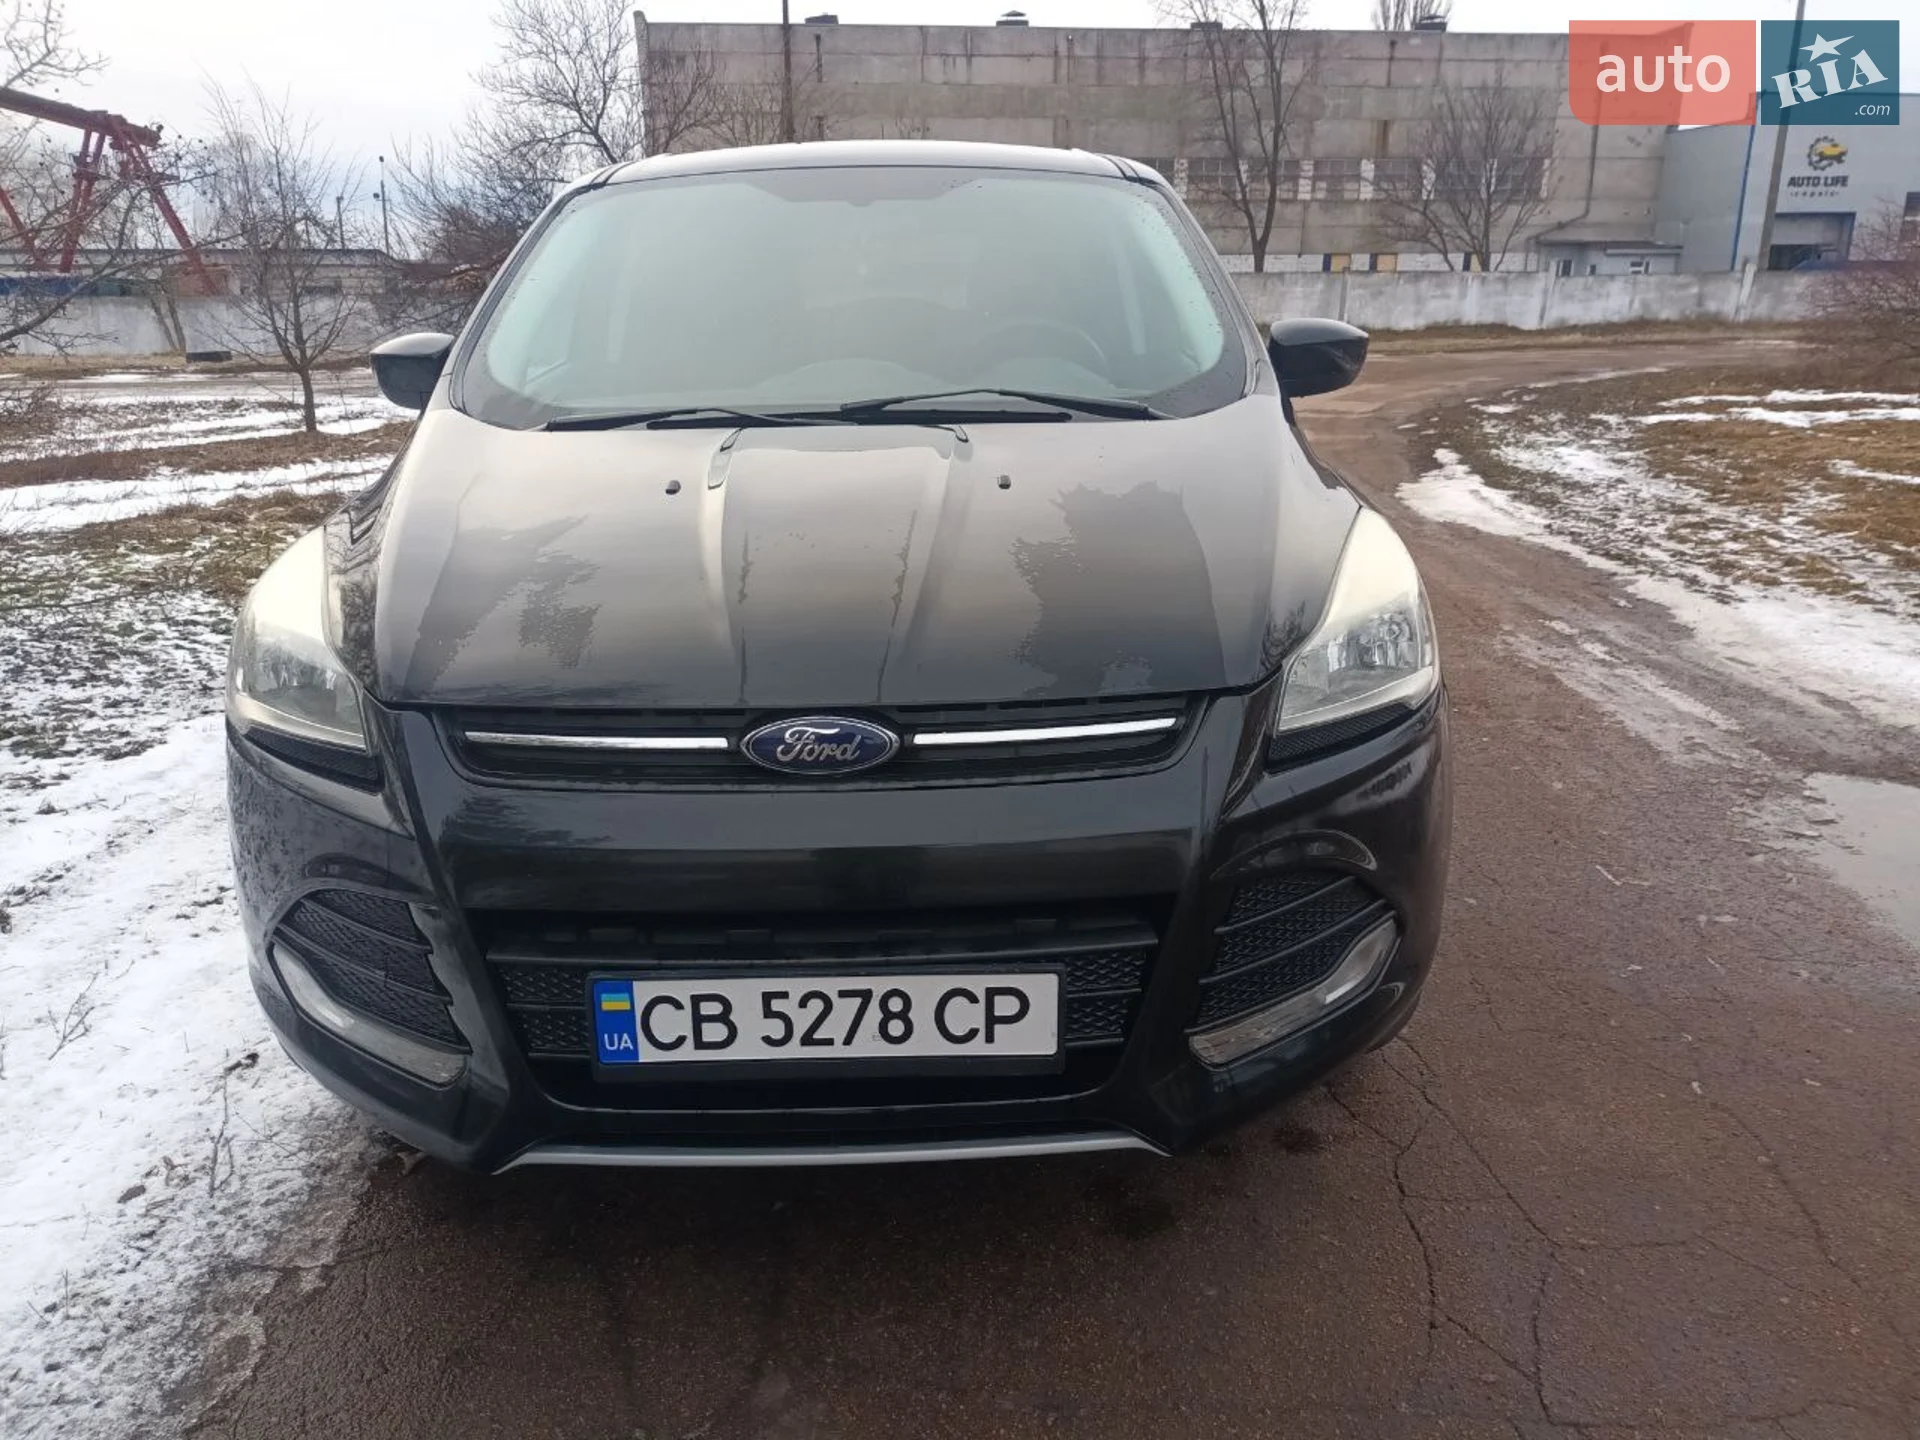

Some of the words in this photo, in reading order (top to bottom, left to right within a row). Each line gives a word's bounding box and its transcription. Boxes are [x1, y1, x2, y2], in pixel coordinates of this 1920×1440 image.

[1787, 176, 1821, 188] AUTO
[1823, 175, 1849, 188] LIFE
[776, 726, 862, 762] Ford
[640, 993, 739, 1051] CB
[761, 988, 914, 1048] 5278
[933, 986, 1031, 1045] CP
[603, 1032, 634, 1051] UA
